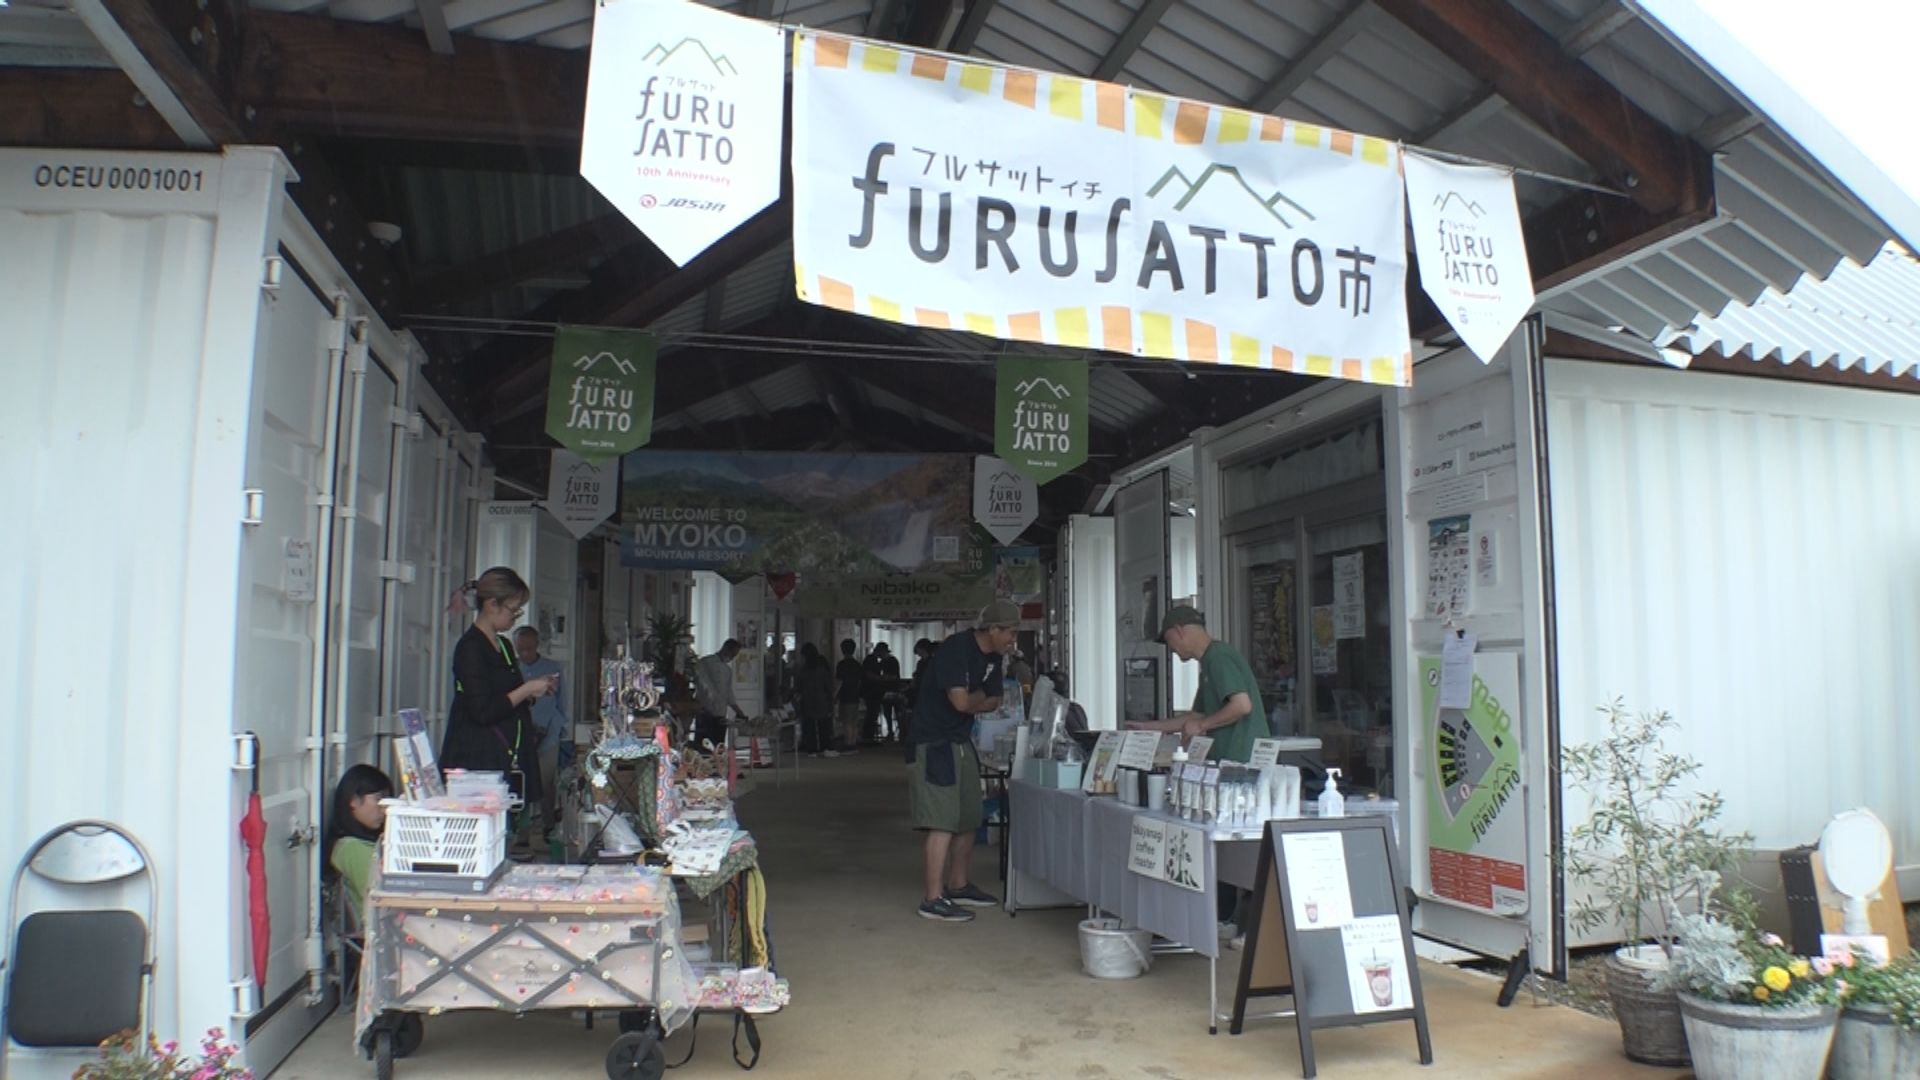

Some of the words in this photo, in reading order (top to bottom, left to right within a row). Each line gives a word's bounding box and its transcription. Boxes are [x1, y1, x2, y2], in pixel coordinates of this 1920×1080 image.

[35, 165, 104, 188] OCEU
[108, 167, 203, 192] 0001001
[637, 166, 662, 177] 10th
[666, 168, 731, 188] Anniversary
[636, 506, 721, 521] WELCOME
[723, 508, 747, 522] TO
[635, 523, 747, 548] MYOKO
[634, 548, 696, 561] MOUNTAIN
[697, 550, 745, 562] RESORT
[861, 580, 941, 595] Nibako
[1472, 673, 1511, 734] map
